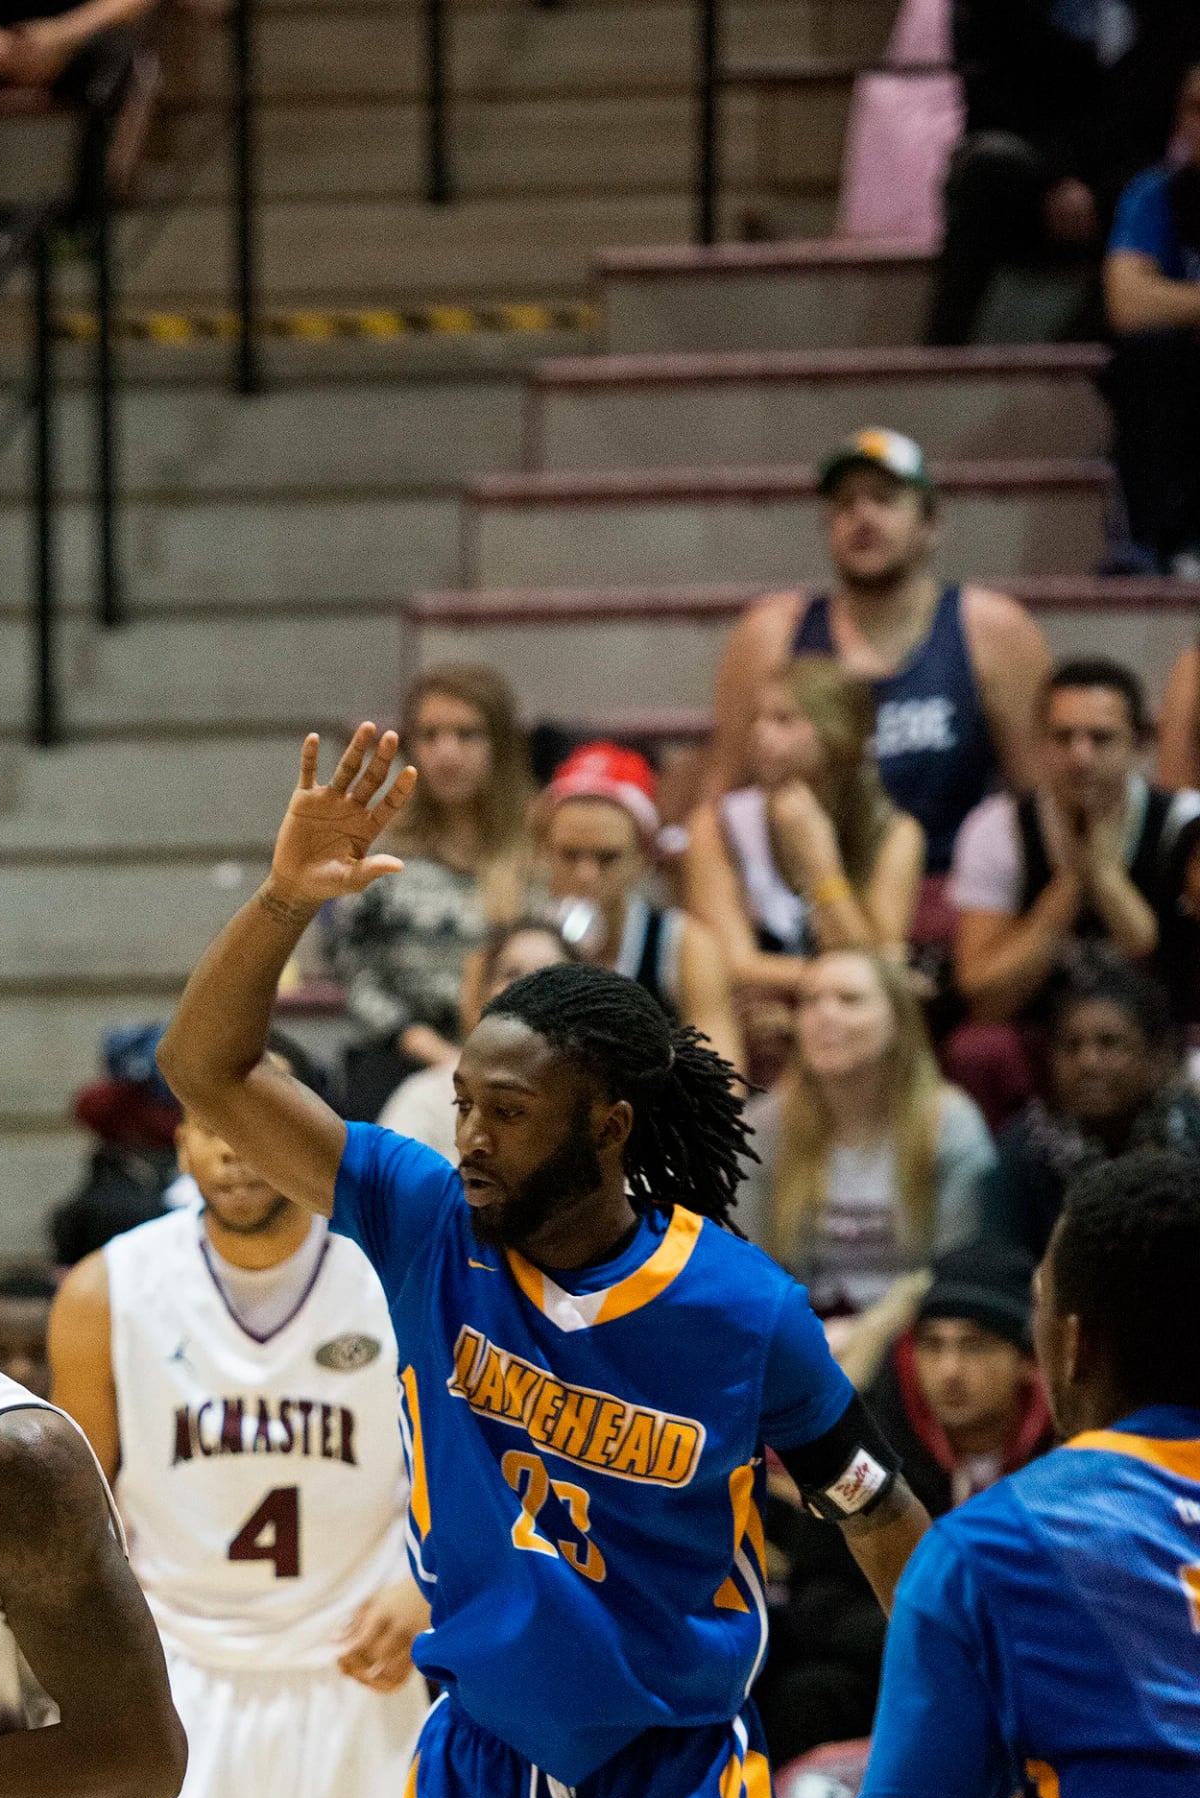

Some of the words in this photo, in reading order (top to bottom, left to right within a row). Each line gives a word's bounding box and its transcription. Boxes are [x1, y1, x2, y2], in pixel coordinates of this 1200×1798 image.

[173, 1397, 358, 1467] MCMASTER
[448, 1326, 706, 1487] LAKEHEAD
[229, 1485, 300, 1577] 4
[501, 1449, 606, 1583] 23
